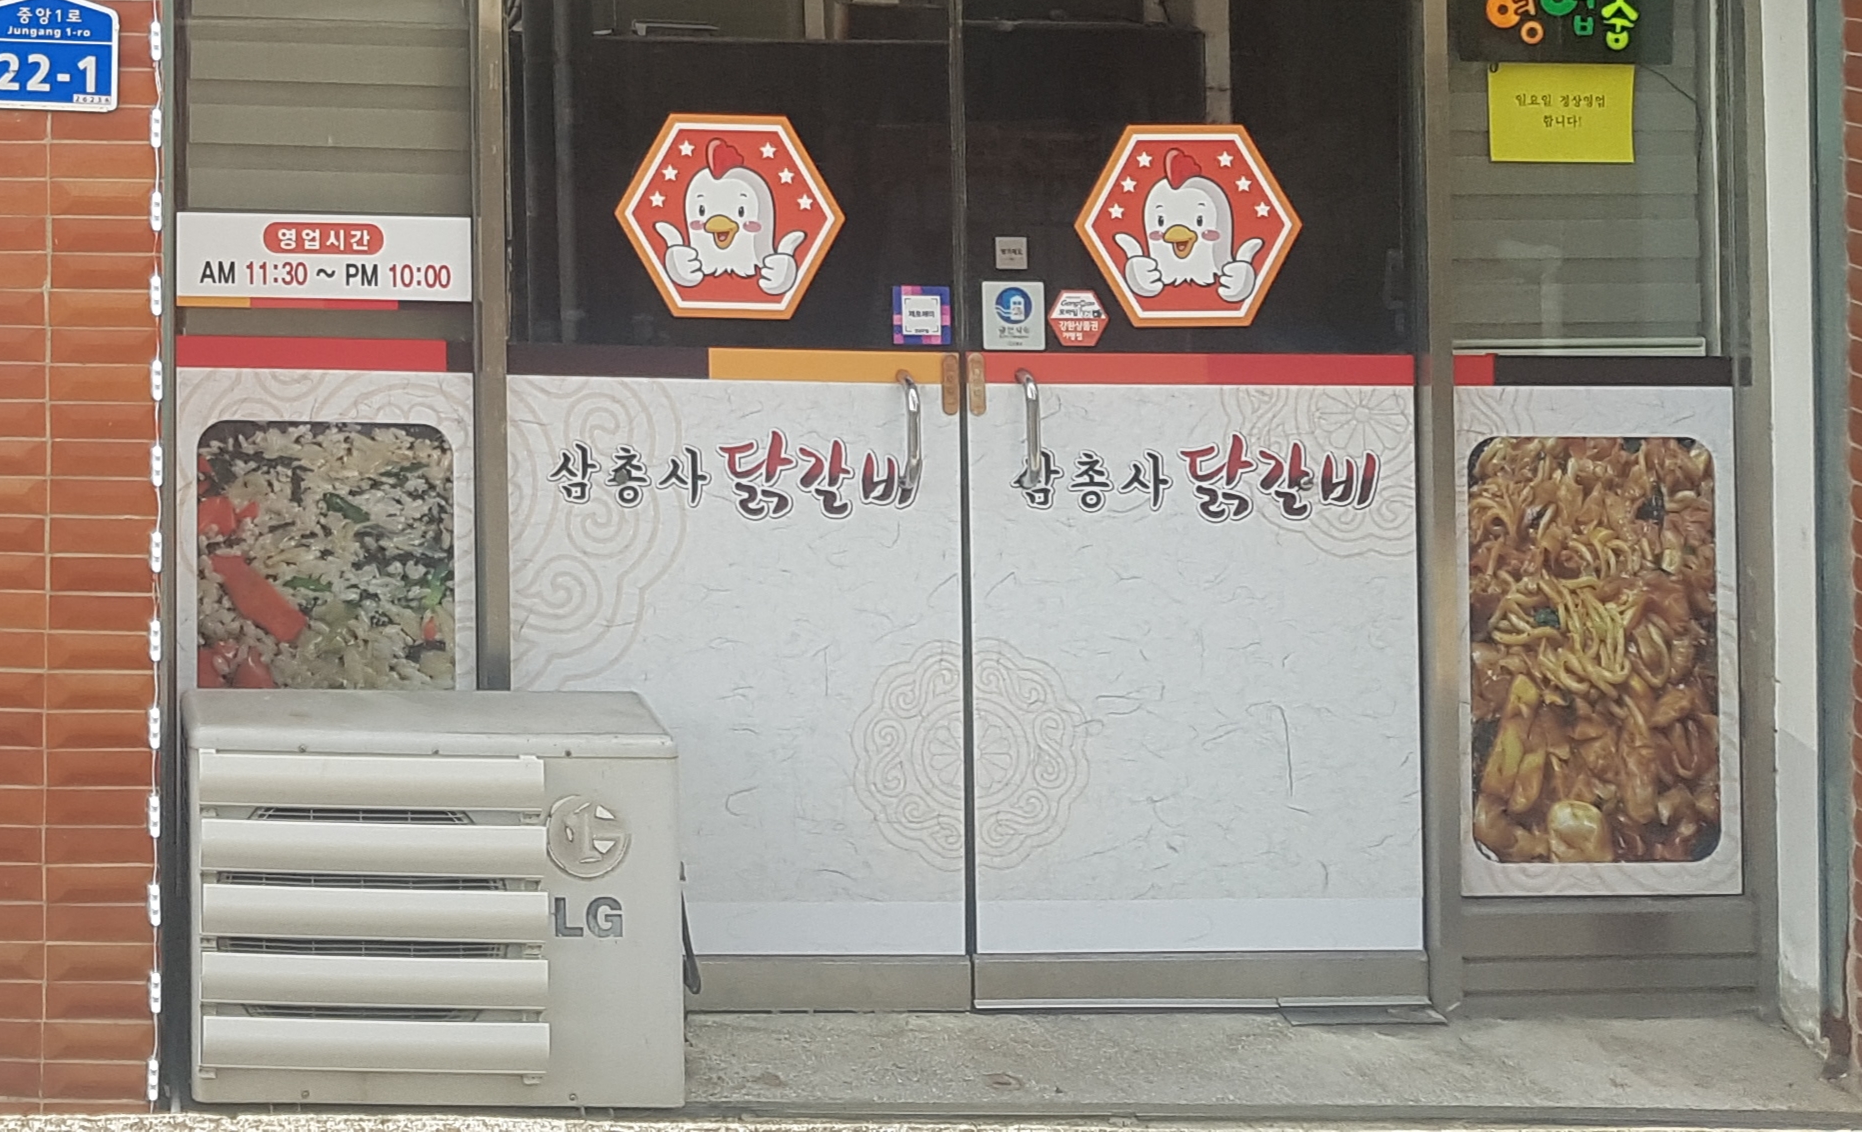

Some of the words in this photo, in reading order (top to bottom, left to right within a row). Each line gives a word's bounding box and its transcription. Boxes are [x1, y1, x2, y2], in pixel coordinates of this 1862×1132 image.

[17, 7, 82, 25] 중앙1로
[7, 26, 61, 38] Jungang
[66, 28, 91, 37] 1-ro
[1515, 93, 1552, 108] 일요일
[1543, 114, 1582, 128] 합니다!
[277, 228, 370, 251] 영업시간
[200, 261, 236, 285] AM
[245, 261, 308, 286] 11:30
[345, 264, 379, 287] PM
[388, 264, 451, 289] 10:00
[546, 443, 711, 509] 삼총사
[718, 430, 922, 521] 닭갈비
[1179, 432, 1381, 522] 닭갈비
[554, 896, 624, 938] LG
